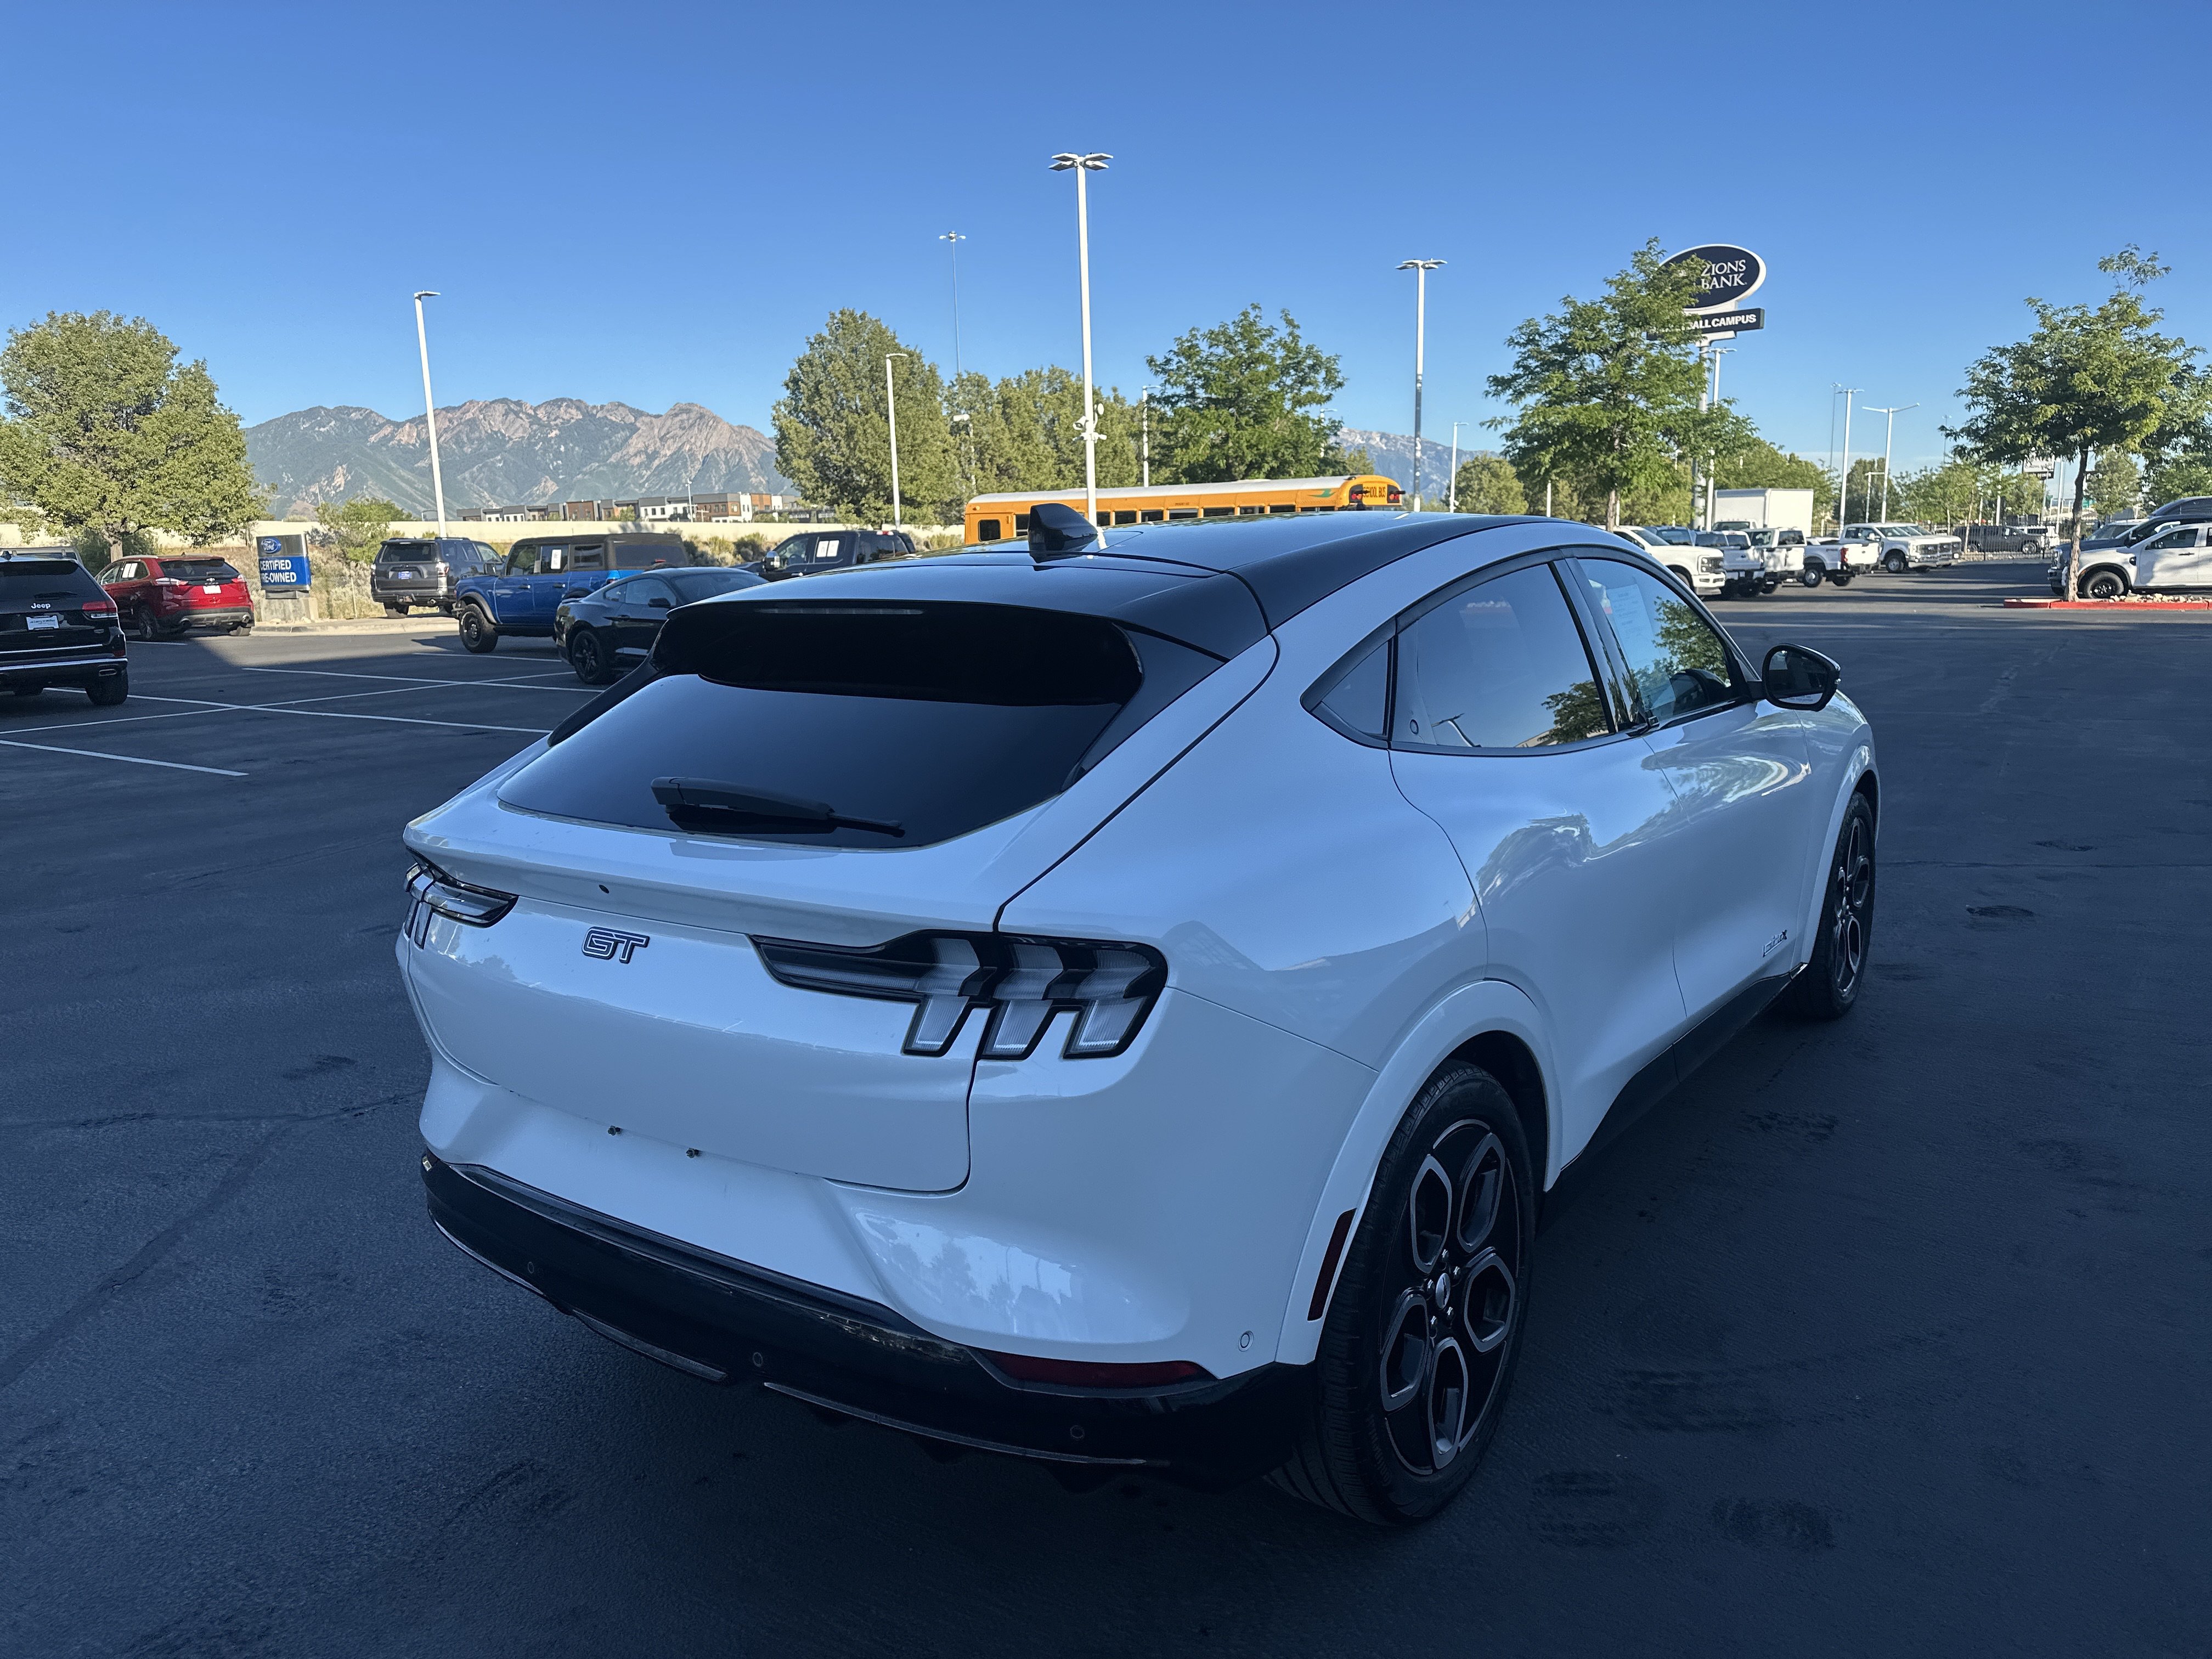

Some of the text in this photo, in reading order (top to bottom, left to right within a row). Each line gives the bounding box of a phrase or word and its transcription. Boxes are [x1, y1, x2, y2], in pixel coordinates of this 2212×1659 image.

[1701, 259, 1746, 276] ZIONS
[1701, 273, 1745, 290] BANK
[1712, 314, 1757, 327] CAMPUS
[1363, 486, 1378, 498] SCHOOL
[264, 542, 274, 551] Ford
[259, 560, 291, 571] CERTIFIED
[582, 926, 650, 964] GT
